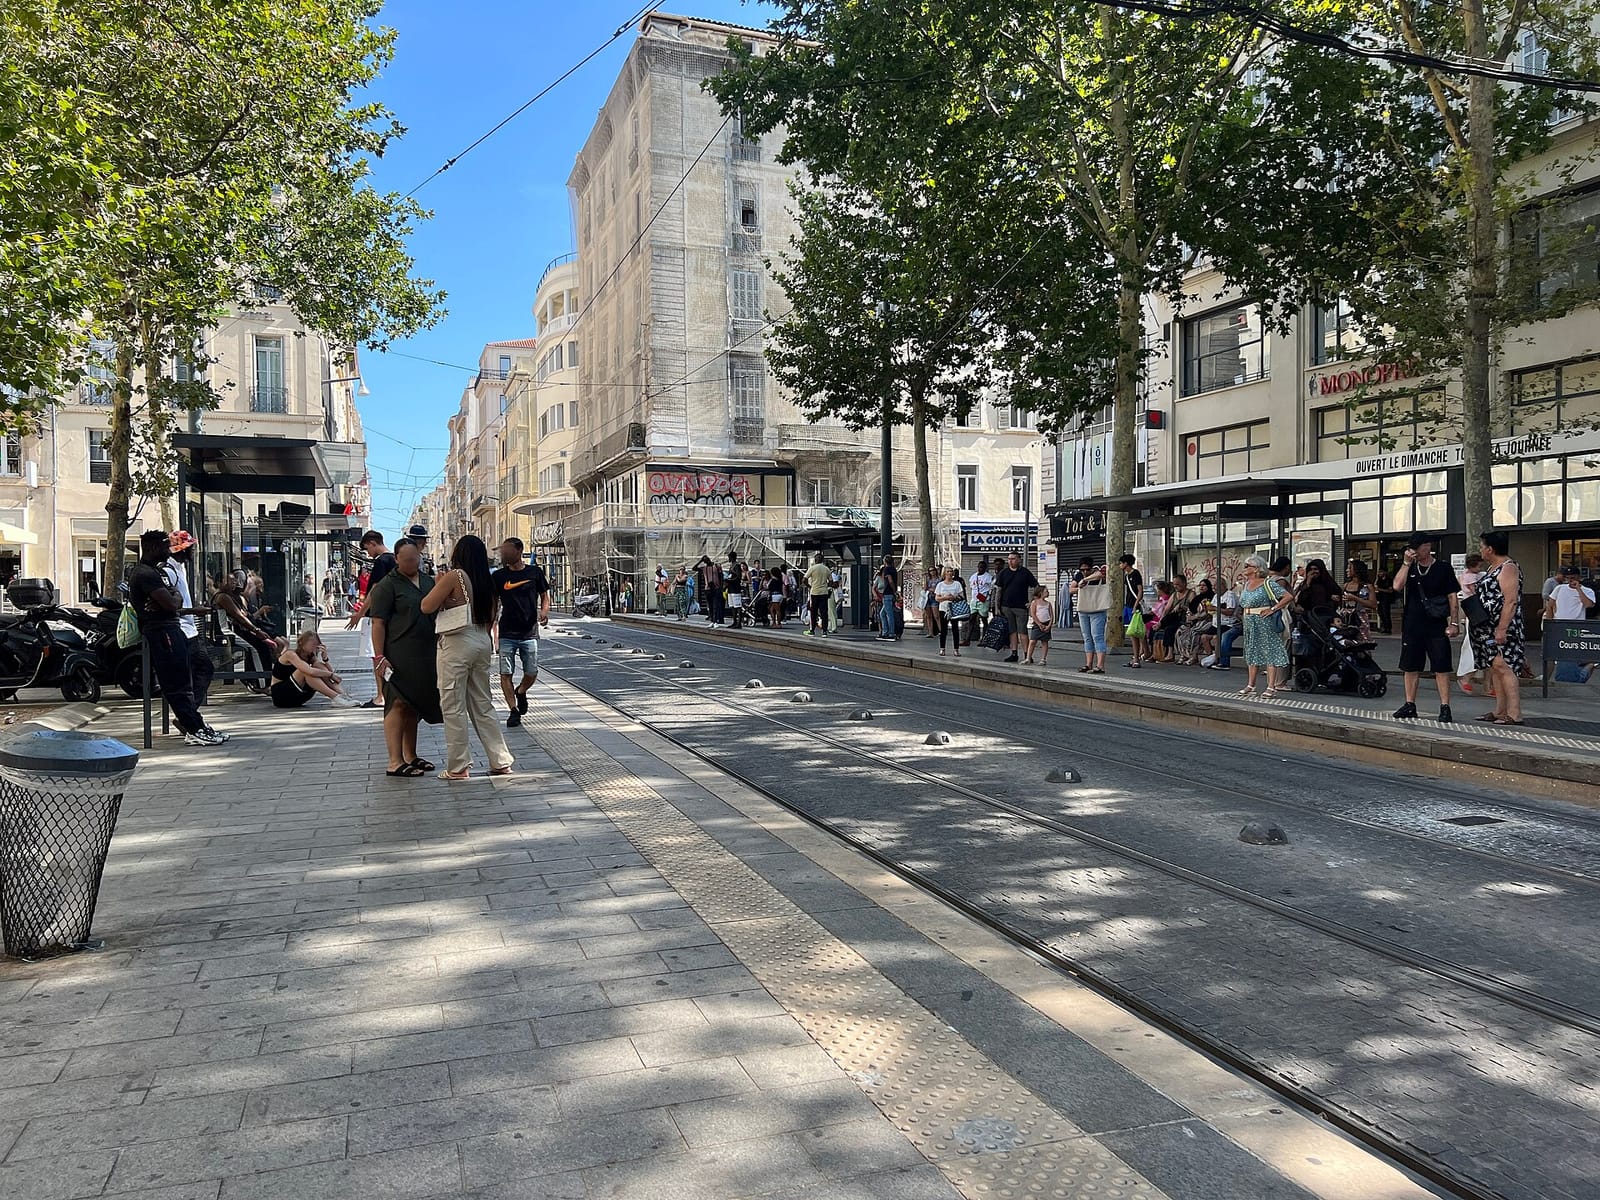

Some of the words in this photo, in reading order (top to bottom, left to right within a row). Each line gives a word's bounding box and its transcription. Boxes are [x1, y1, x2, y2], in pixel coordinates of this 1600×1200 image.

[1356, 457, 1387, 473] OUVERT
[1389, 457, 1399, 469] LE
[1401, 449, 1448, 467] DIMANCHE
[1065, 516, 1083, 533] Toi
[1087, 515, 1096, 531] &
[971, 535, 984, 545] LA
[986, 535, 1038, 545] GOULETE
[1565, 628, 1578, 637] T3
[1559, 640, 1579, 650] Cours
[1580, 641, 1588, 650] St
